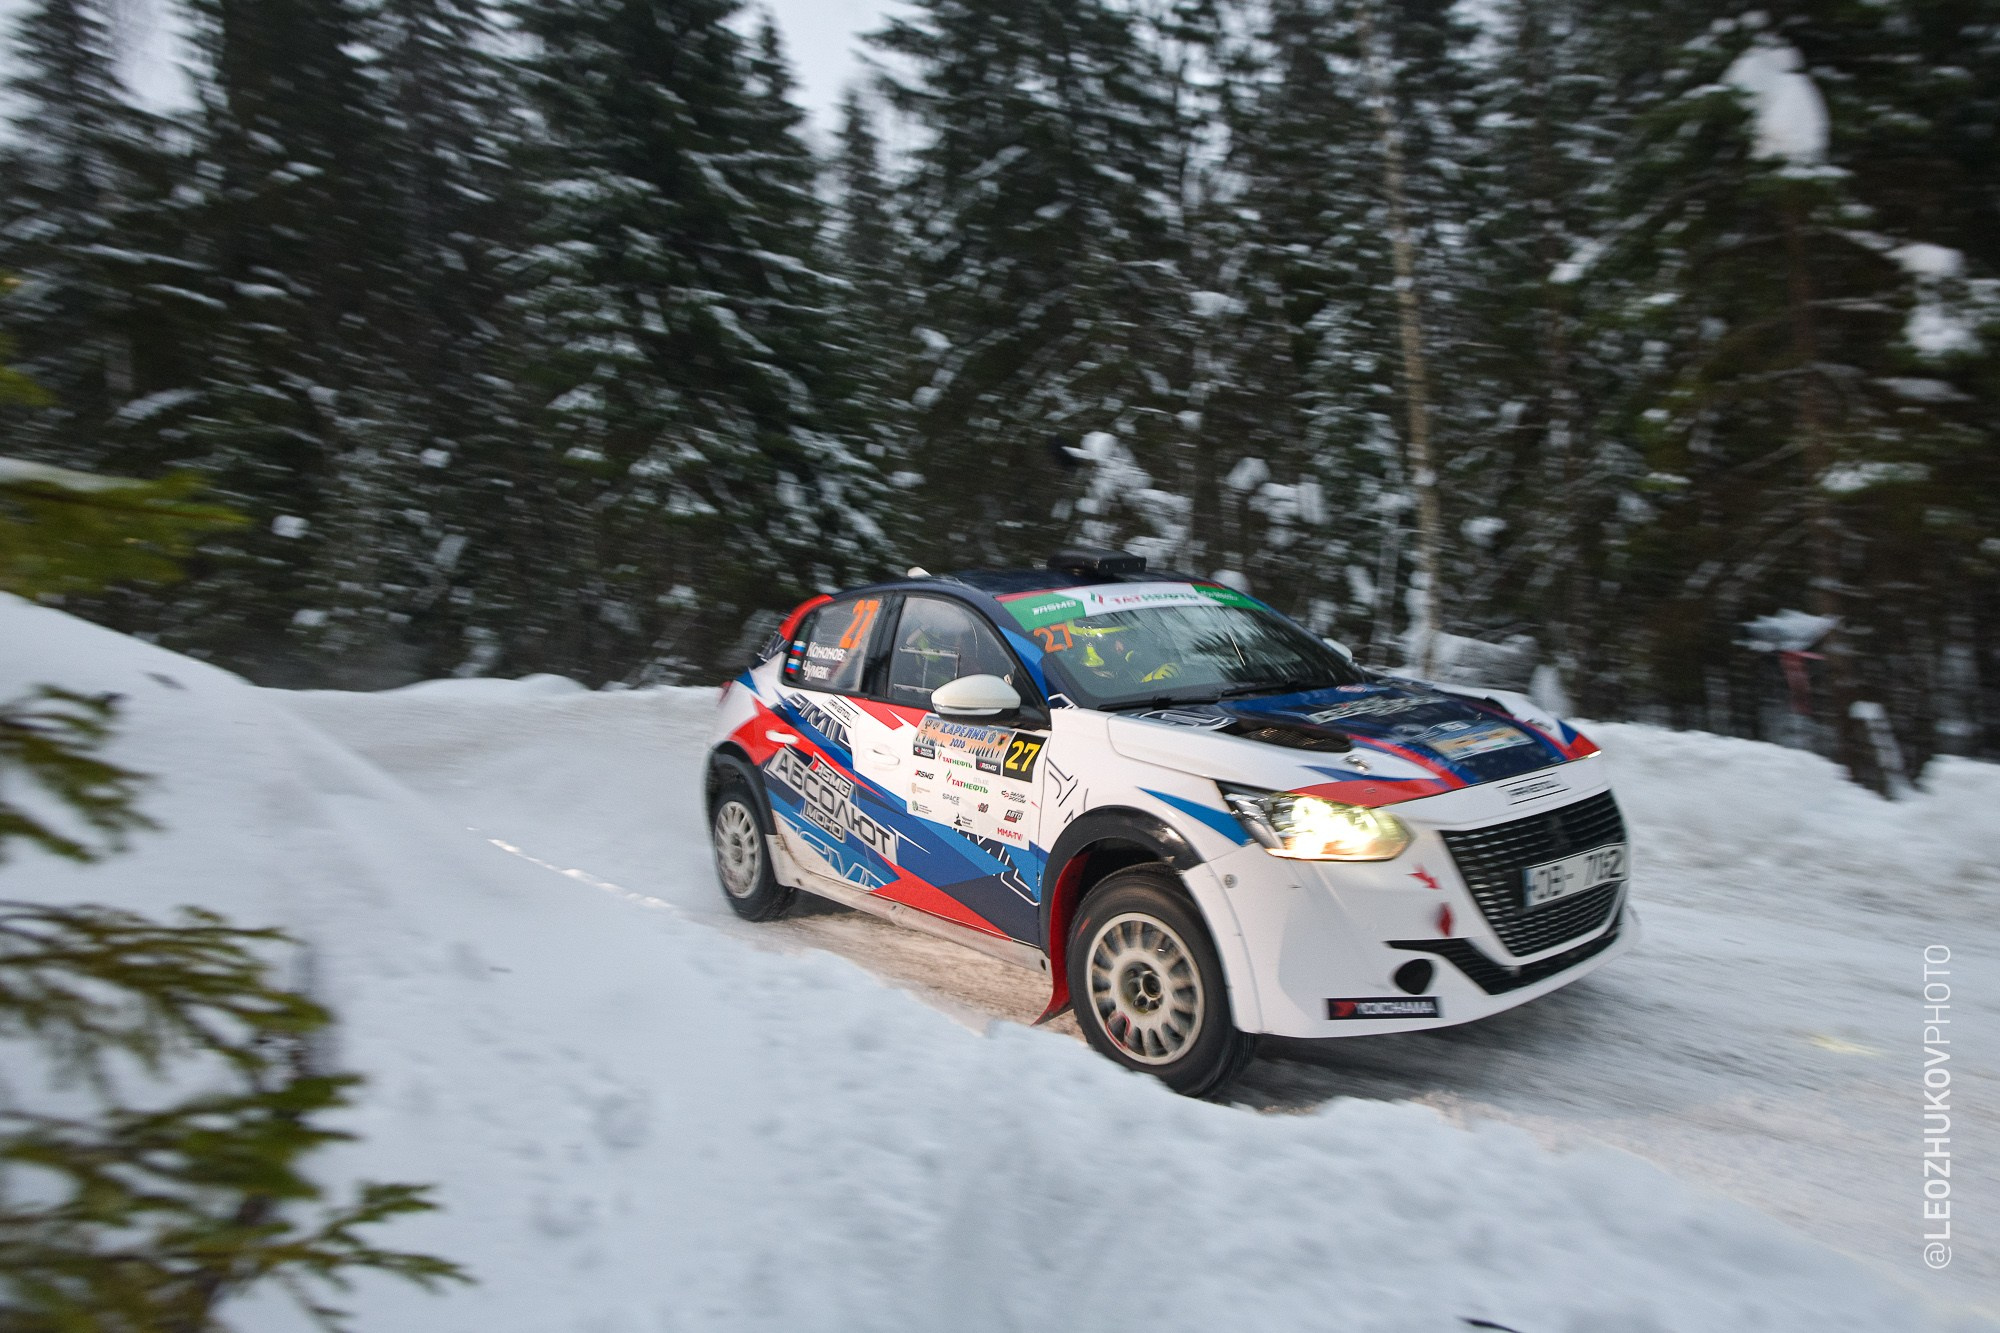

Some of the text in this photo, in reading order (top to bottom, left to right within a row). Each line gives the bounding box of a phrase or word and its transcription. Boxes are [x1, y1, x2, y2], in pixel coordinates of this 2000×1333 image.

[839, 599, 880, 649] 27
[1034, 624, 1073, 653] 27
[806, 642, 847, 661] Кононов
[802, 660, 830, 681] Чумак
[940, 722, 988, 742] КАРЕЛИЯ
[942, 756, 973, 769] ТАТНЕФТЬ
[1005, 740, 1041, 772] 27
[952, 779, 988, 794] ТАТНЕФТЬ
[775, 752, 890, 855] АБСОЛЮТ
[942, 793, 960, 804] SPACE
[806, 805, 843, 840] МОНО
